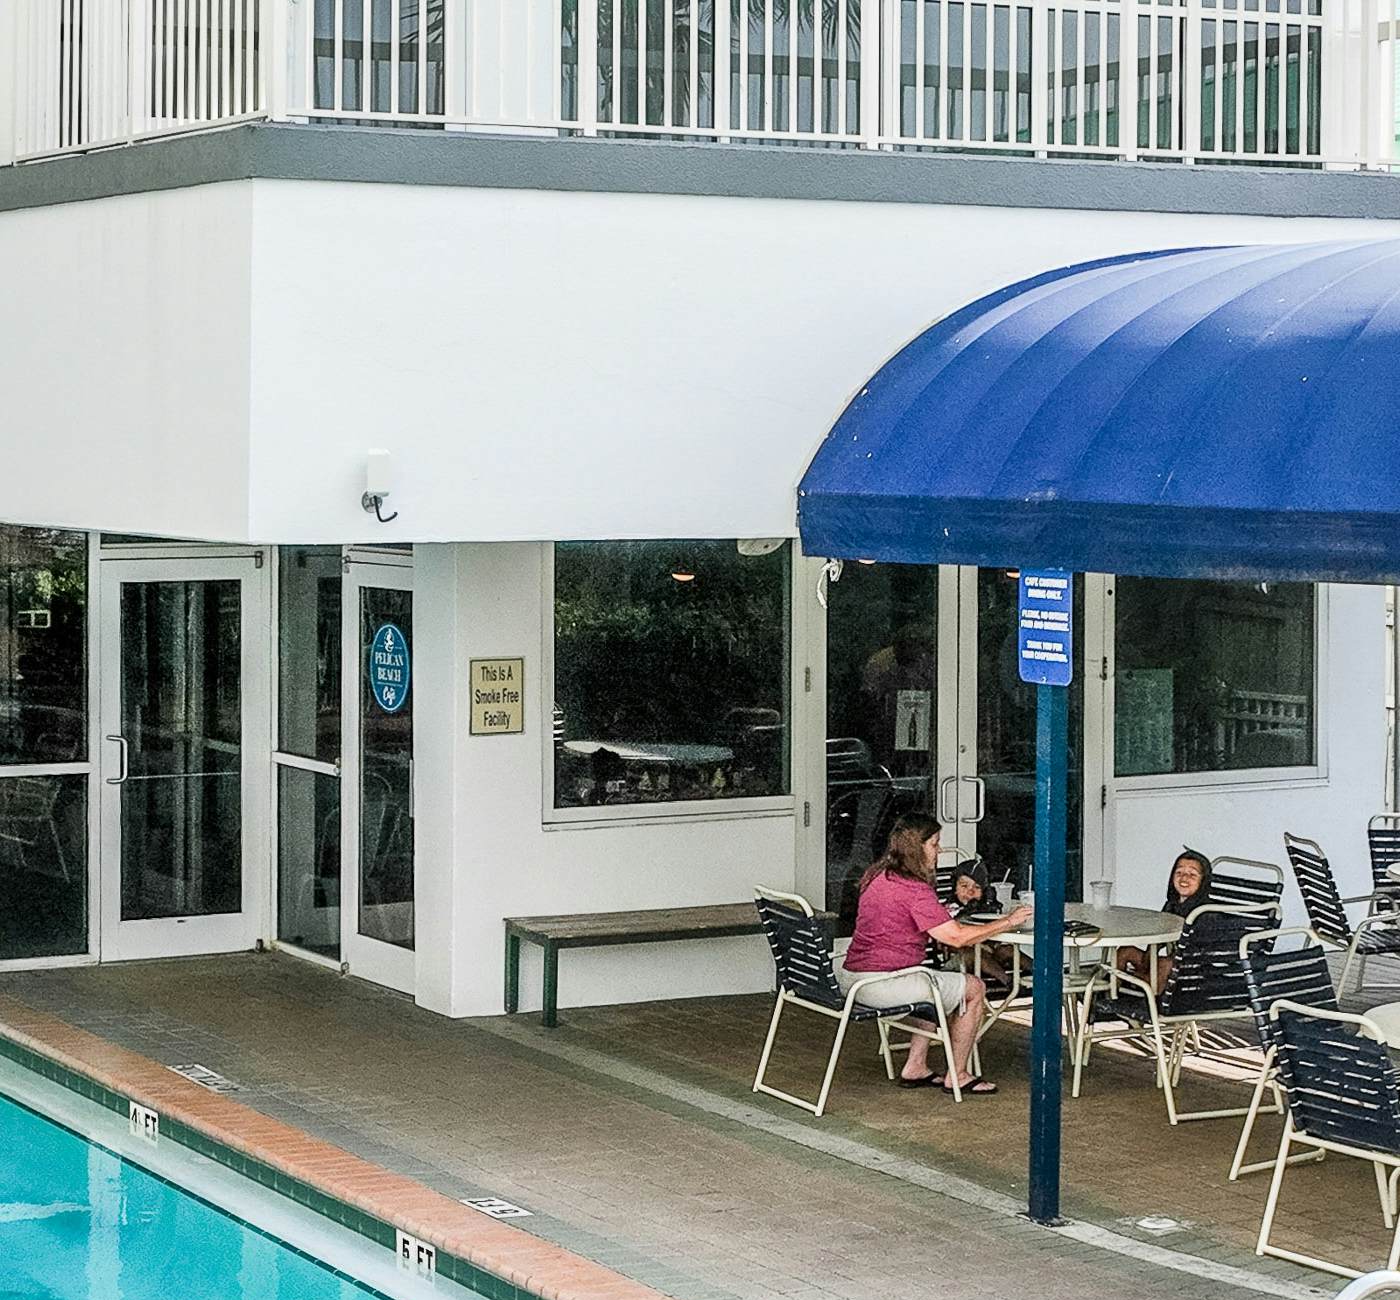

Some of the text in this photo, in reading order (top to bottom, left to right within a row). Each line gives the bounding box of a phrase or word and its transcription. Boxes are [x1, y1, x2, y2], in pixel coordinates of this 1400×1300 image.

[375, 651, 404, 666] PELICAN
[377, 667, 401, 682] BEACH
[481, 665, 514, 682] This Is A
[475, 688, 519, 704] Smoke Free
[484, 711, 511, 729] Facility
[145, 1113, 157, 1132] FT
[402, 1238, 433, 1270] 5 FT
